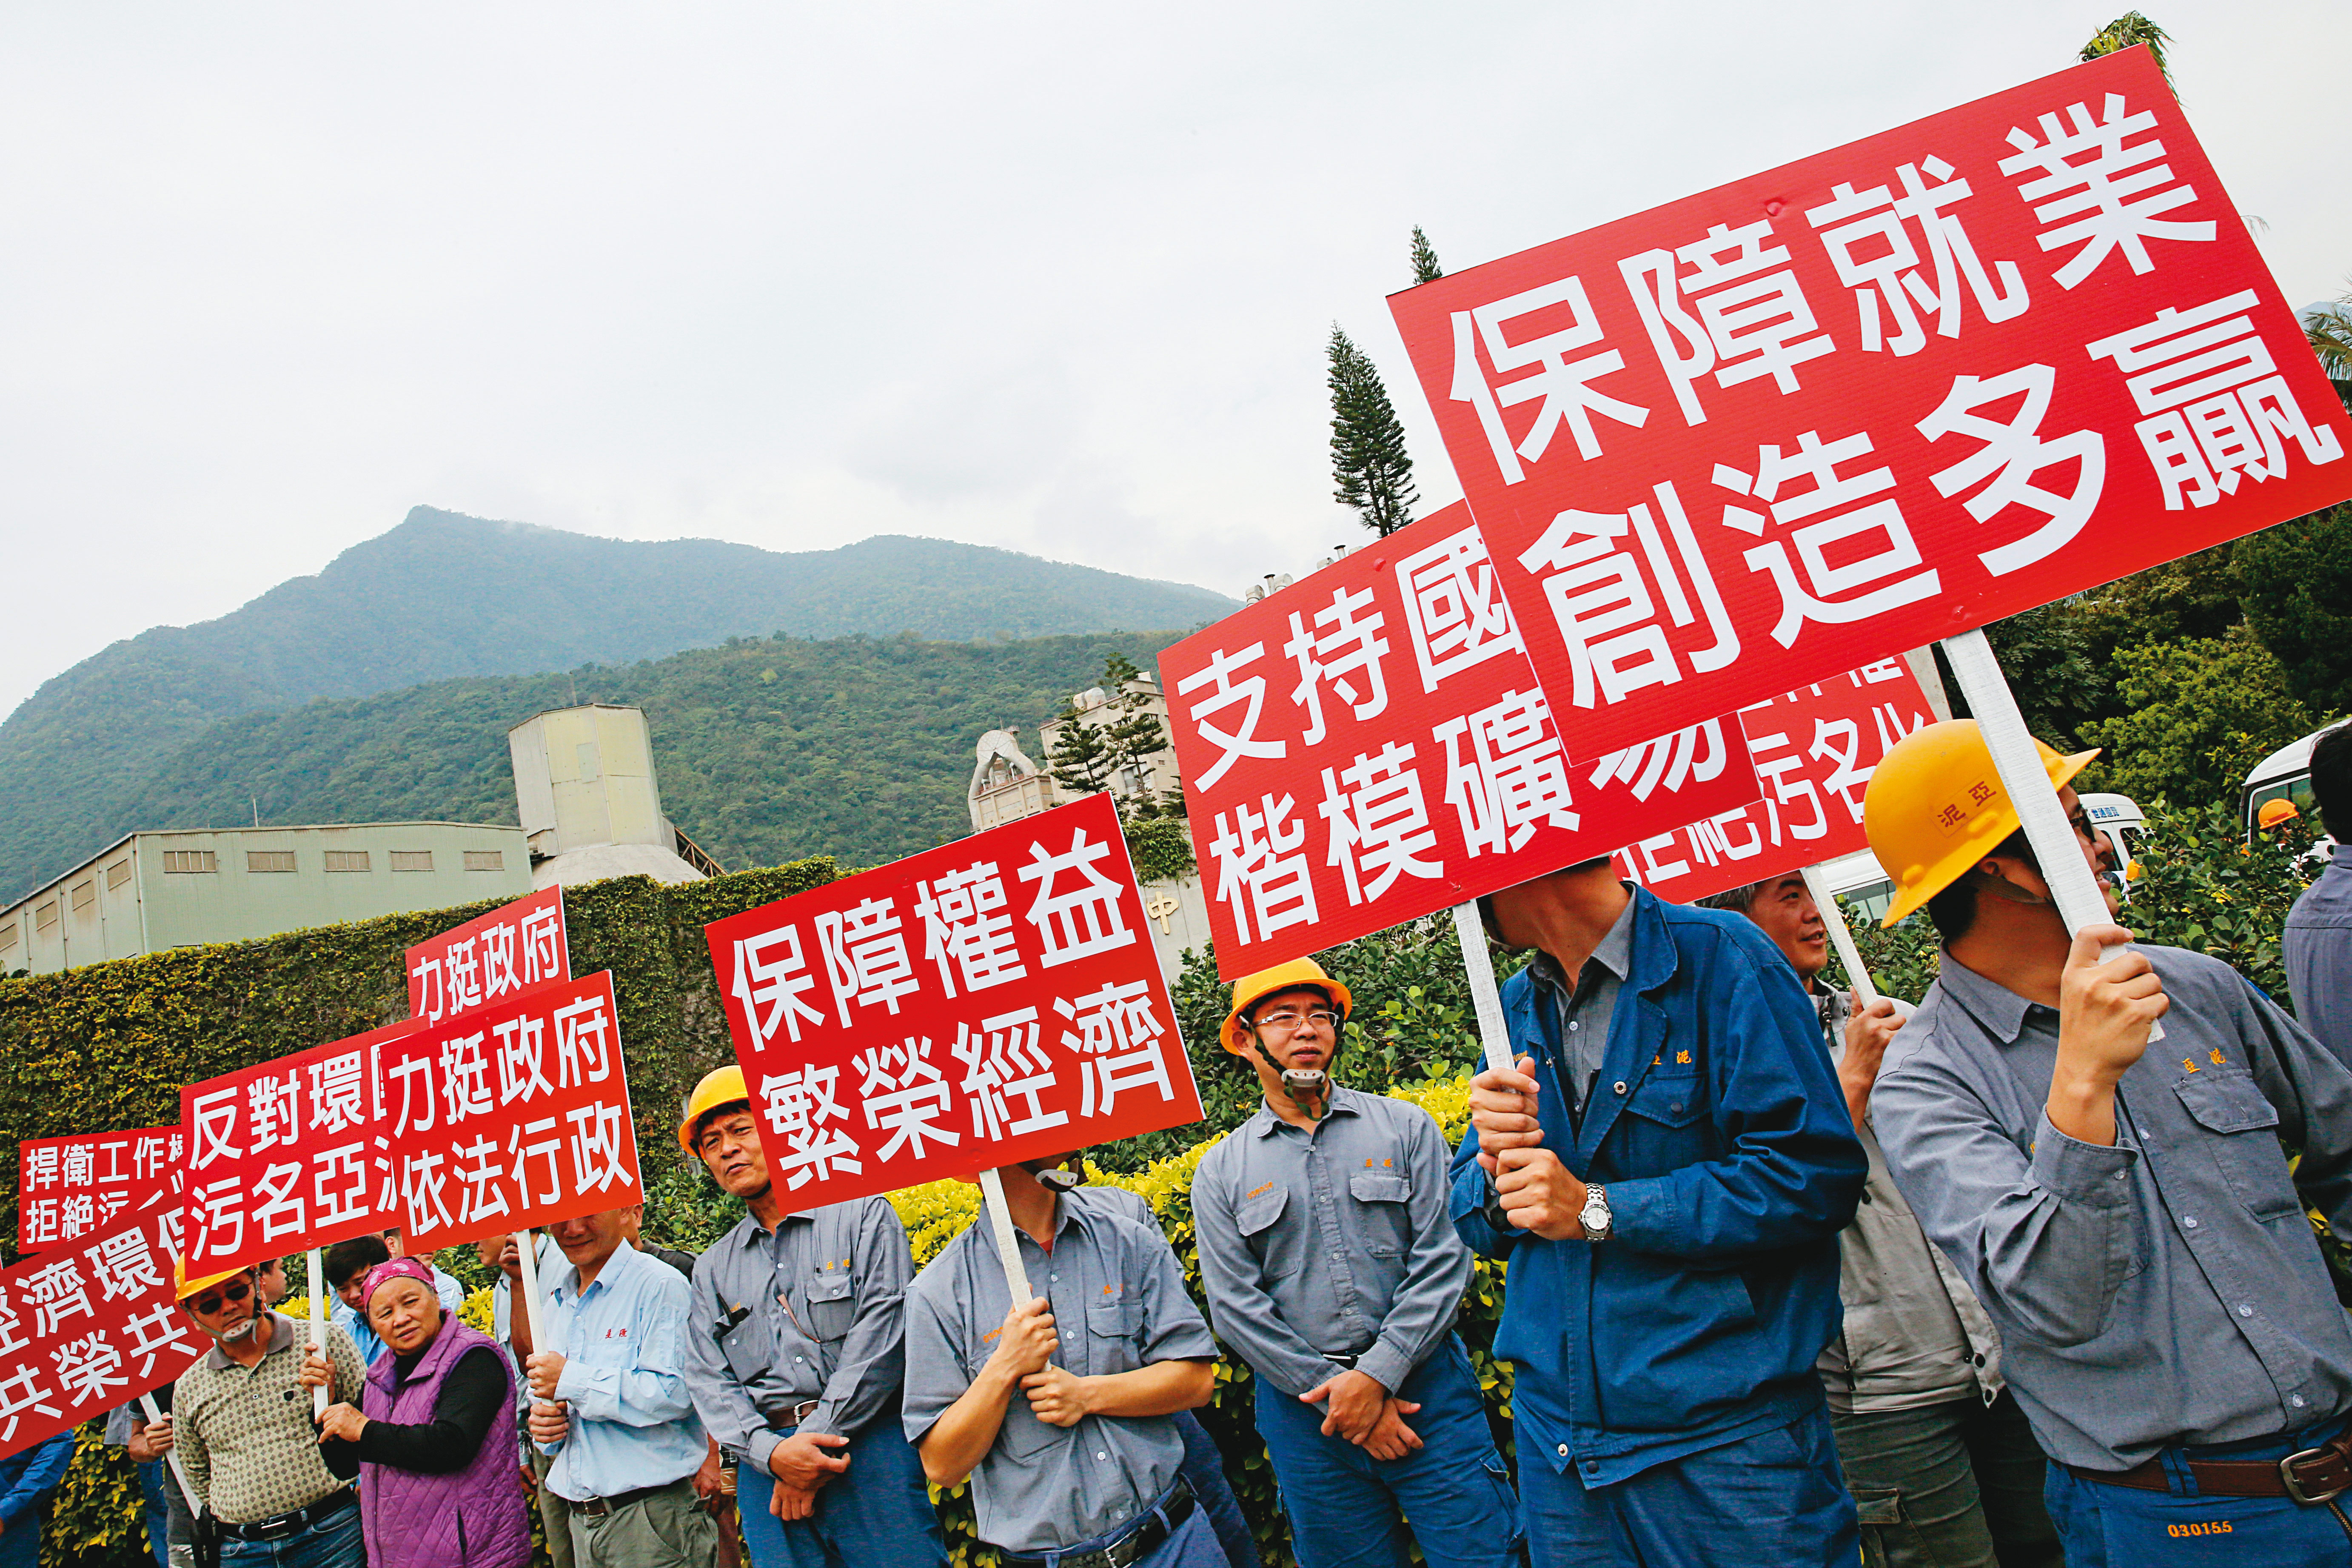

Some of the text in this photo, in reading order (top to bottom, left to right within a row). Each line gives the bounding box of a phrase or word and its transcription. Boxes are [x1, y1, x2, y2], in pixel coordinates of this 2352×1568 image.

[1449, 92, 2217, 486] 保障就業
[1516, 288, 2344, 710] 創造多贏
[412, 905, 559, 1022] 力挺政府
[731, 827, 1137, 1052] 保障權益
[1146, 891, 1179, 935] 中
[388, 995, 610, 1139] 力挺政府
[759, 979, 1174, 1192] 繁榮經濟
[400, 1100, 634, 1237] 依法行政
[2167, 1520, 2233, 1538] 030155
